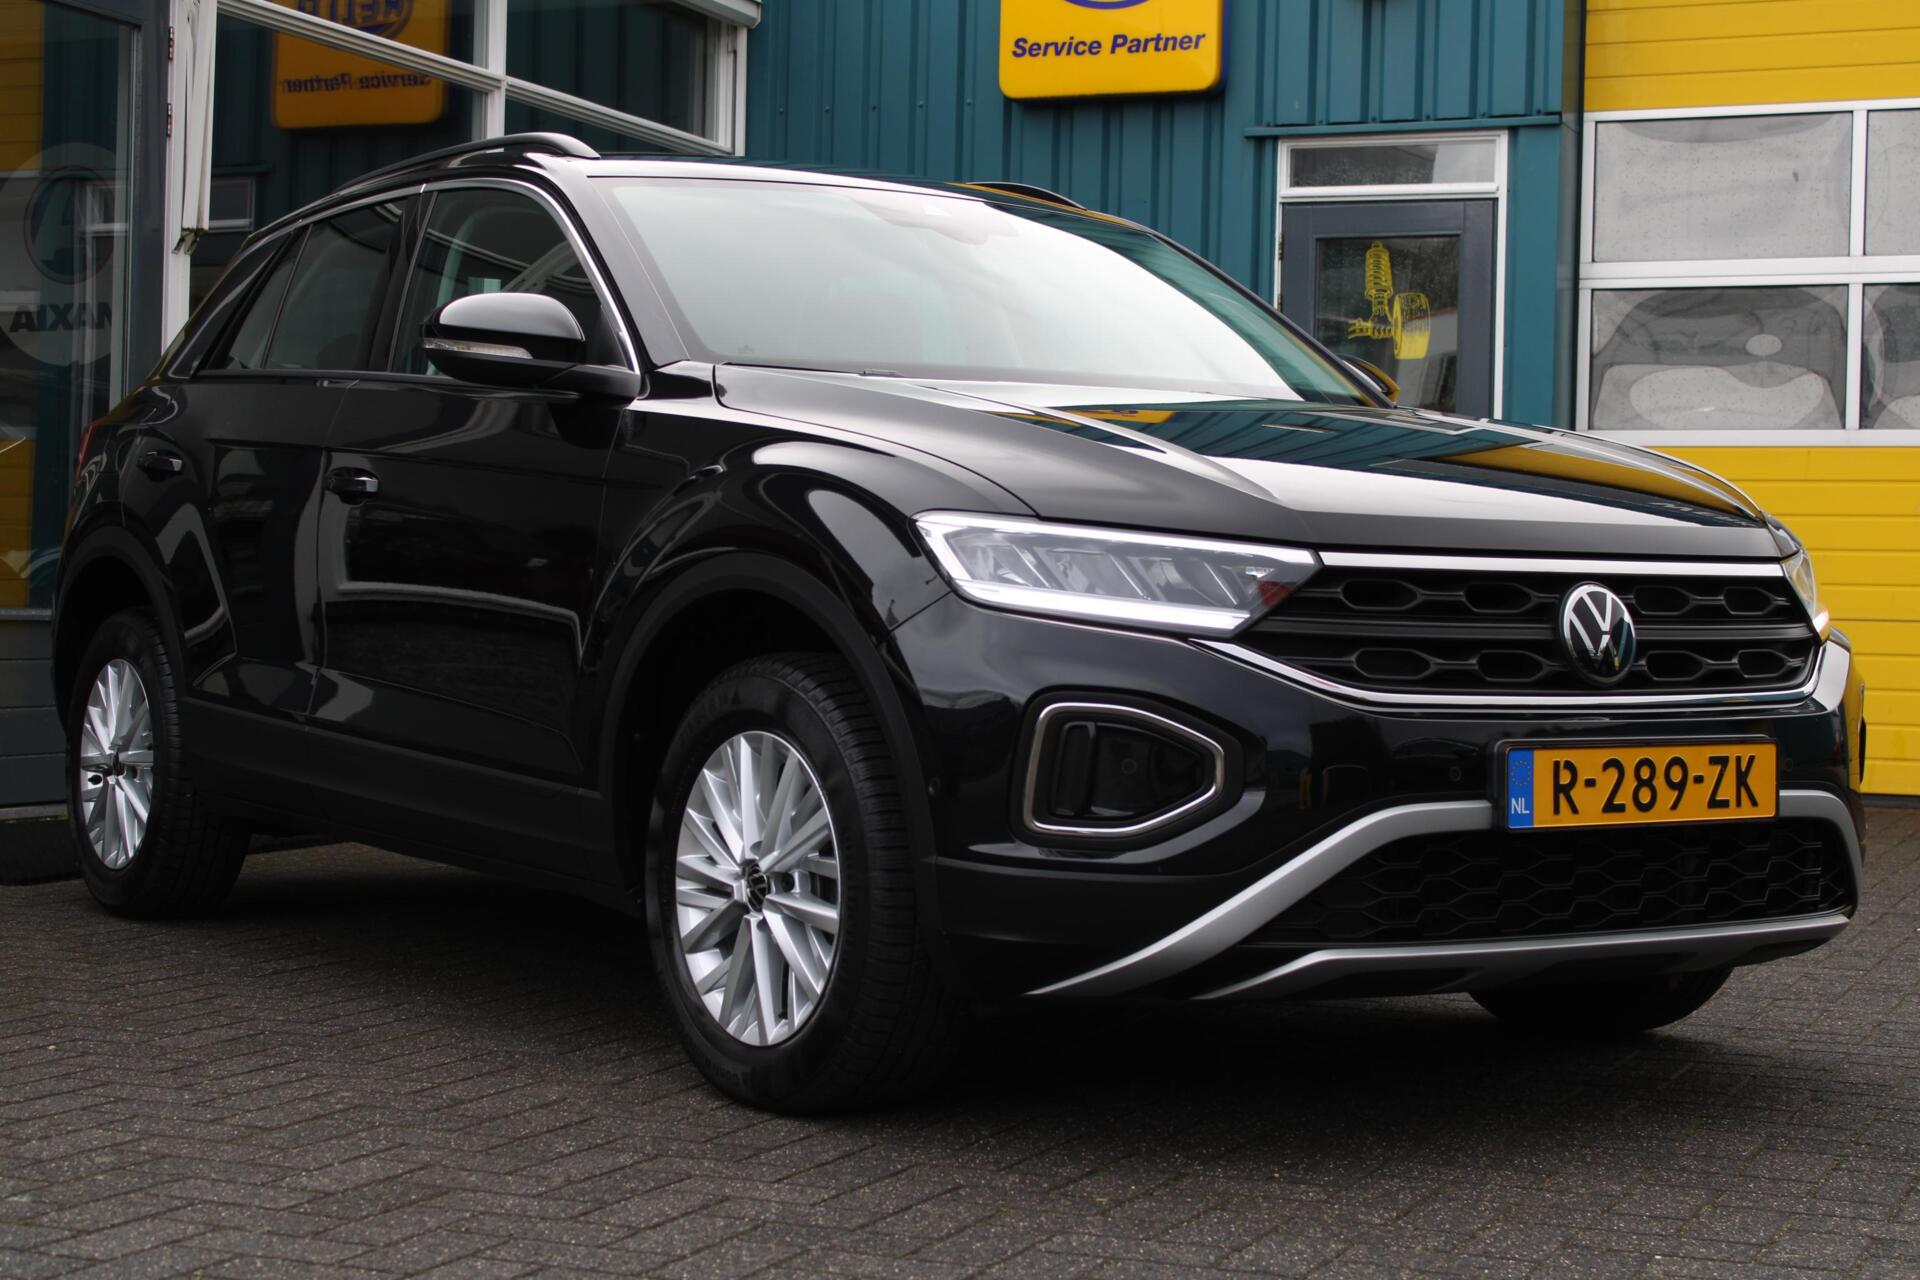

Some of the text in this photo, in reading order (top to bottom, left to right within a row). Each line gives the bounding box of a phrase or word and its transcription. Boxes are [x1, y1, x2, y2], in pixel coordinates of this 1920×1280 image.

[1011, 32, 1206, 58] Service Partner
[1552, 755, 1760, 816] R-289-ZK
[1510, 797, 1530, 815] NL
